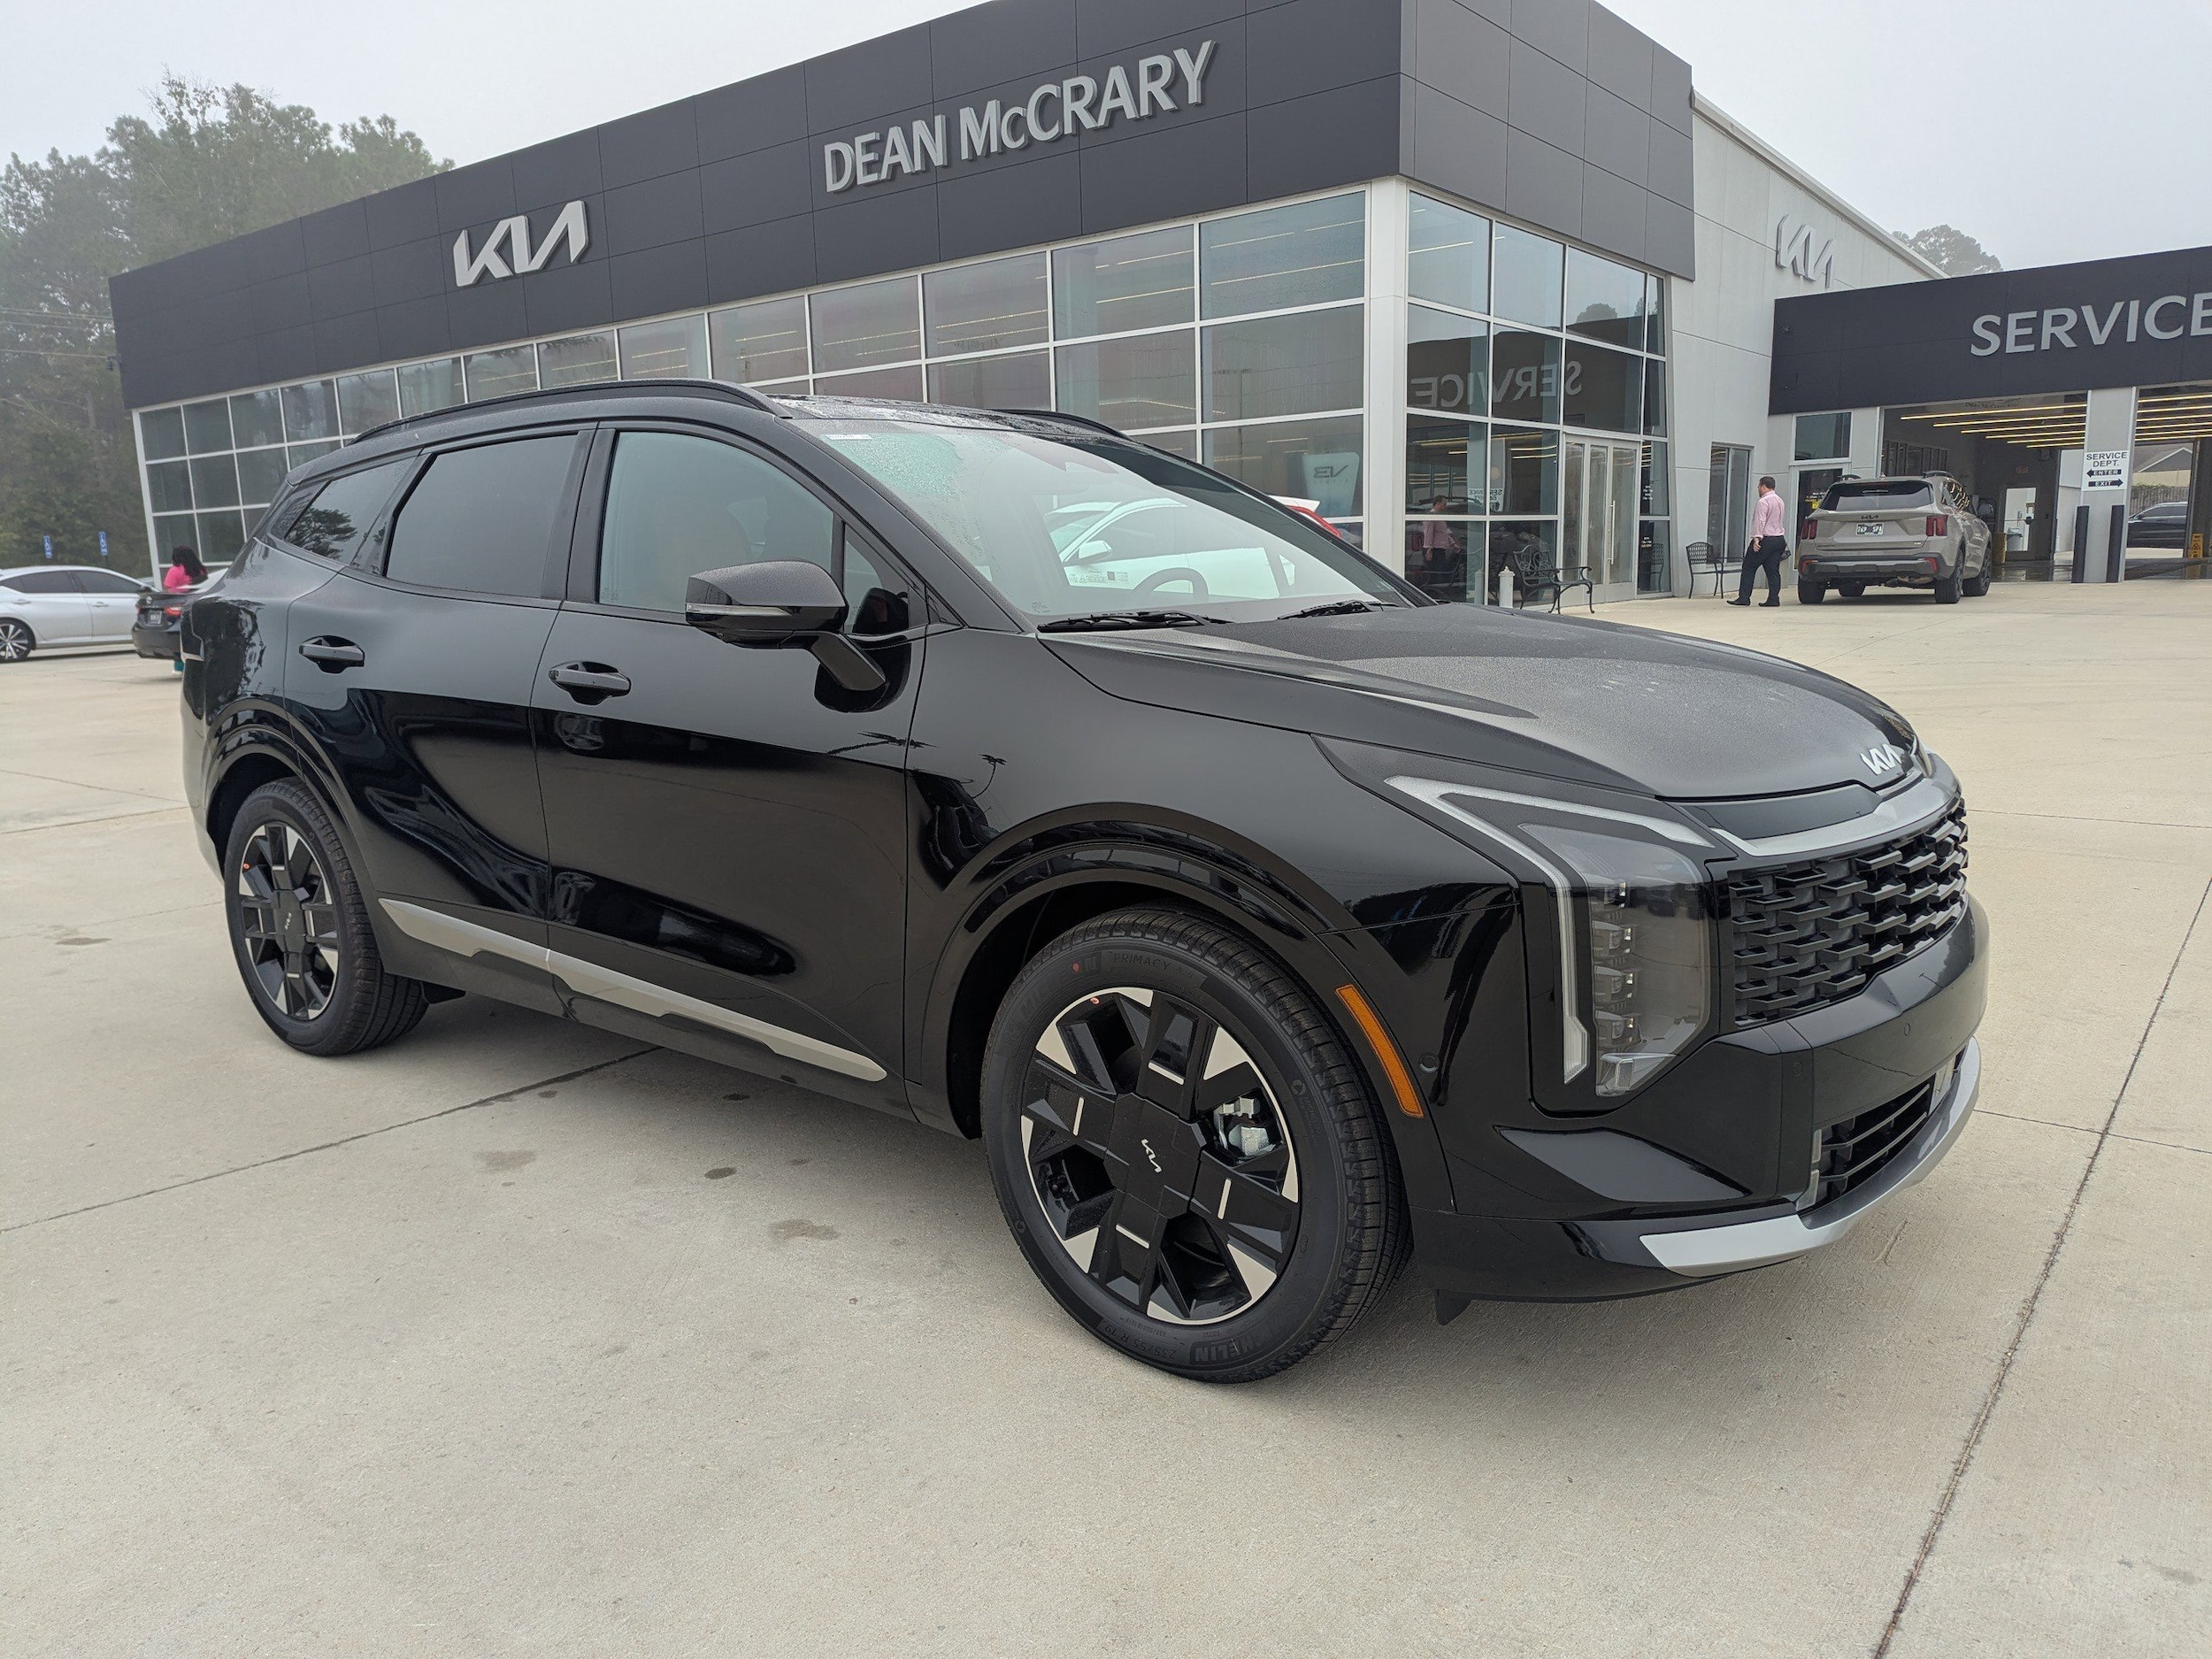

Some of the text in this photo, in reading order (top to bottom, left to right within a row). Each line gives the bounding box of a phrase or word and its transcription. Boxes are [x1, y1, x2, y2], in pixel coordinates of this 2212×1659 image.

[824, 39, 1217, 193] DEAN McCRARY
[453, 200, 588, 288] KIA
[1775, 213, 1836, 289] KIA
[1970, 292, 2212, 357] SERVICE
[2086, 451, 2127, 461] SERVICE
[1860, 743, 1902, 775] KIA
[1113, 952, 1172, 972] PRIMACY
[1141, 1139, 1162, 1173] KIA
